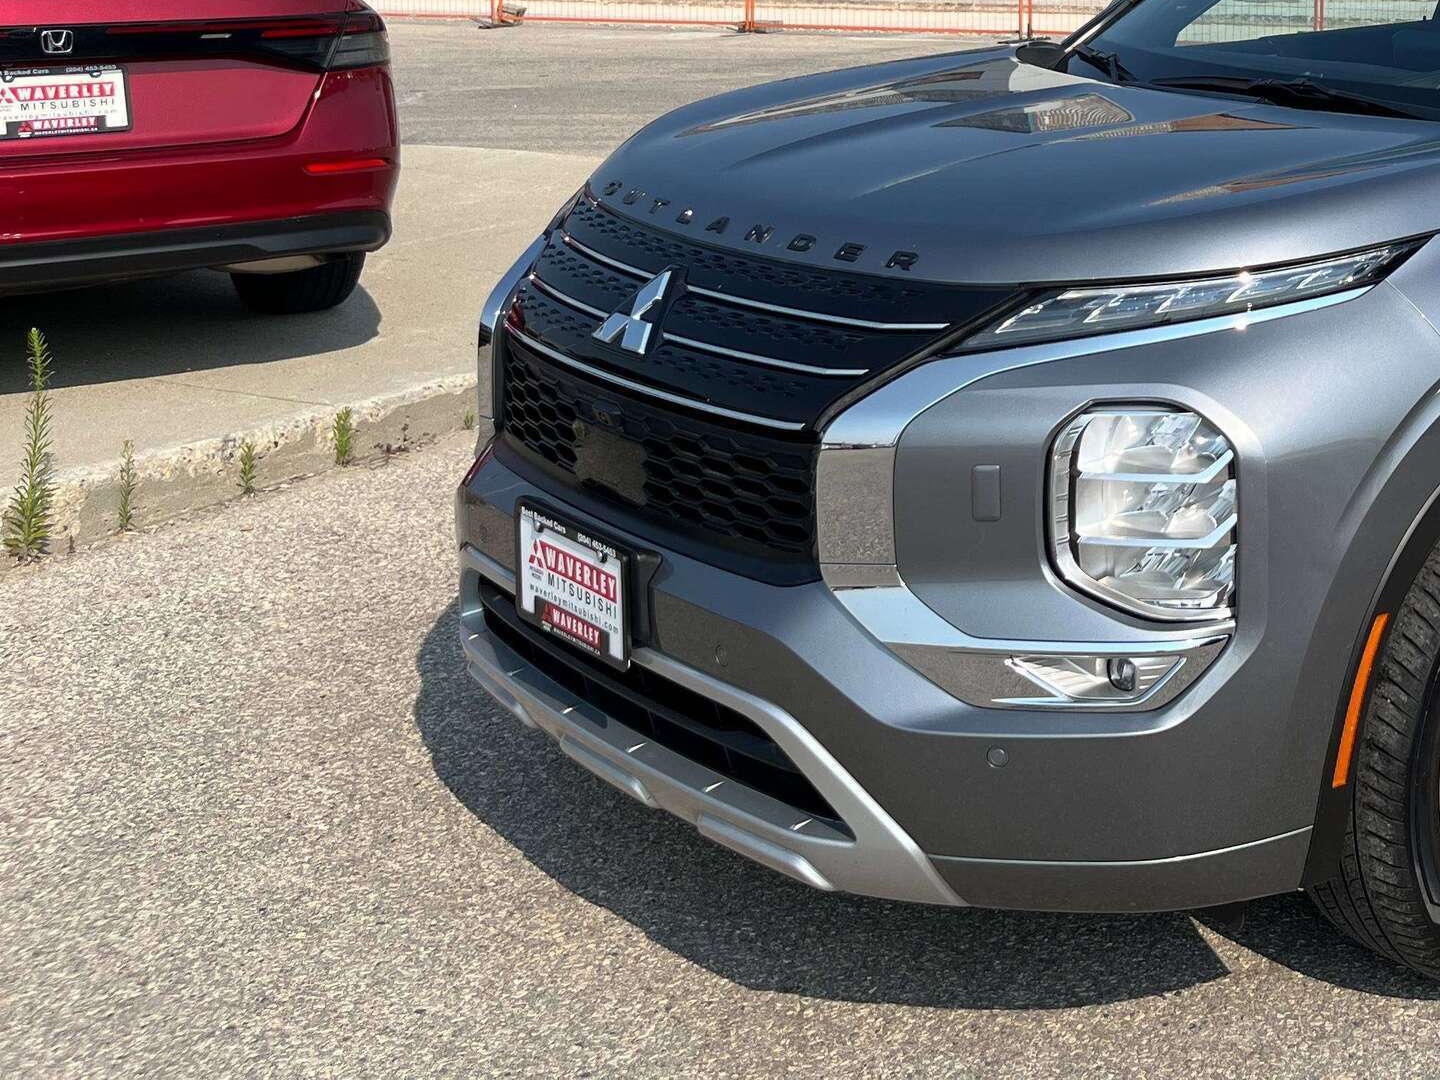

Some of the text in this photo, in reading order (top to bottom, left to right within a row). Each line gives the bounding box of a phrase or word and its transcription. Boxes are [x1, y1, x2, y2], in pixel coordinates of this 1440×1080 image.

[17, 84, 113, 100] WAVERLEY
[21, 99, 115, 111] MITSUBISHI
[32, 117, 97, 131] WAVERLEY
[602, 181, 919, 271] OUTLANDER
[546, 545, 616, 600] WAVERLEY
[547, 573, 617, 619] MITSUBISHI
[552, 608, 599, 644] WAVERLEY
